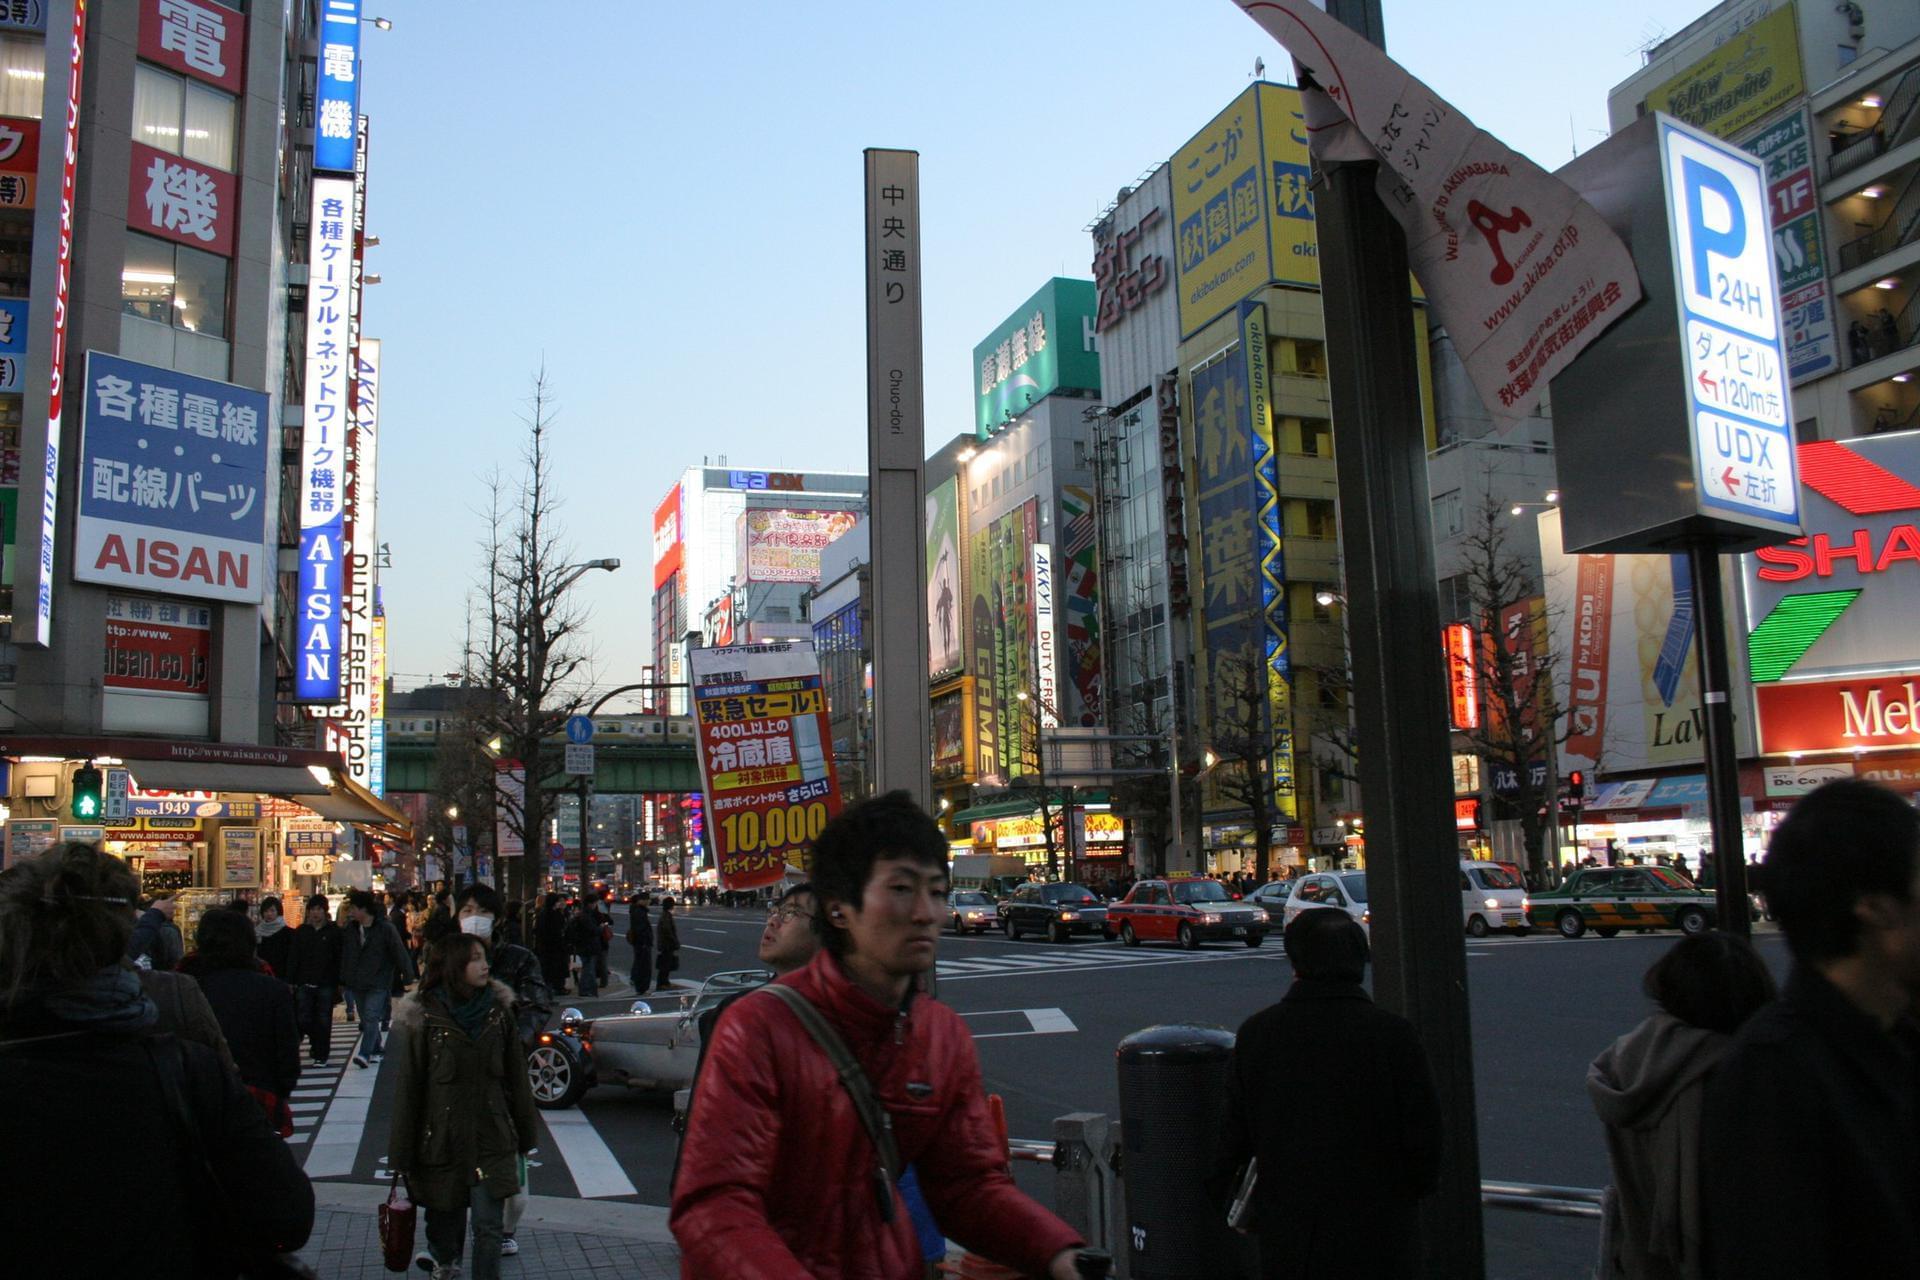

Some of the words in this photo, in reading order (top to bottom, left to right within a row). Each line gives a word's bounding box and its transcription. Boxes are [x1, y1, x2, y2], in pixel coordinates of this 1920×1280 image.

[1187, 115, 1245, 194] ここが
[1443, 161, 1511, 197] AKIHABARA
[881, 184, 907, 304] 中央通り
[1181, 176, 1259, 272] 秋葉館
[1681, 154, 1746, 299] P
[1191, 251, 1256, 305] akibakan.com
[1483, 223, 1580, 331] www.akiba.or.jp
[1716, 272, 1764, 320] 24H
[310, 198, 345, 513] 各種ケーブル・ネットワーク機器
[1250, 321, 1266, 427] akibakan.com
[1696, 331, 1774, 383] ダイビル
[95, 374, 259, 447] 各種電線
[357, 358, 376, 437] AKKY
[889, 369, 905, 435] Chuo-dori
[1720, 376, 1781, 420] 120m先
[1715, 421, 1774, 471] UDX
[91, 457, 257, 521] 配線パーツ
[1743, 471, 1778, 506] 左折
[94, 533, 250, 589] AISAN
[352, 552, 369, 620] DUTY
[1036, 552, 1051, 604] AKKY
[305, 534, 334, 681] AISAN
[1580, 594, 1595, 646] KDDI
[350, 632, 366, 697] FREE
[1040, 630, 1053, 672] DUTY
[701, 690, 821, 723] 緊急セール!
[710, 719, 790, 739] 400L以上の
[976, 647, 995, 775] GAME
[1573, 668, 1601, 737] au
[349, 709, 366, 778] SHOP
[708, 736, 794, 772] 冷蔵庫
[737, 768, 788, 785] 対象機種
[787, 782, 829, 803] さらに!
[135, 806, 158, 816] Since
[157, 801, 191, 815] 1949
[721, 801, 827, 854] 10,000
[723, 852, 779, 875] ポイント
